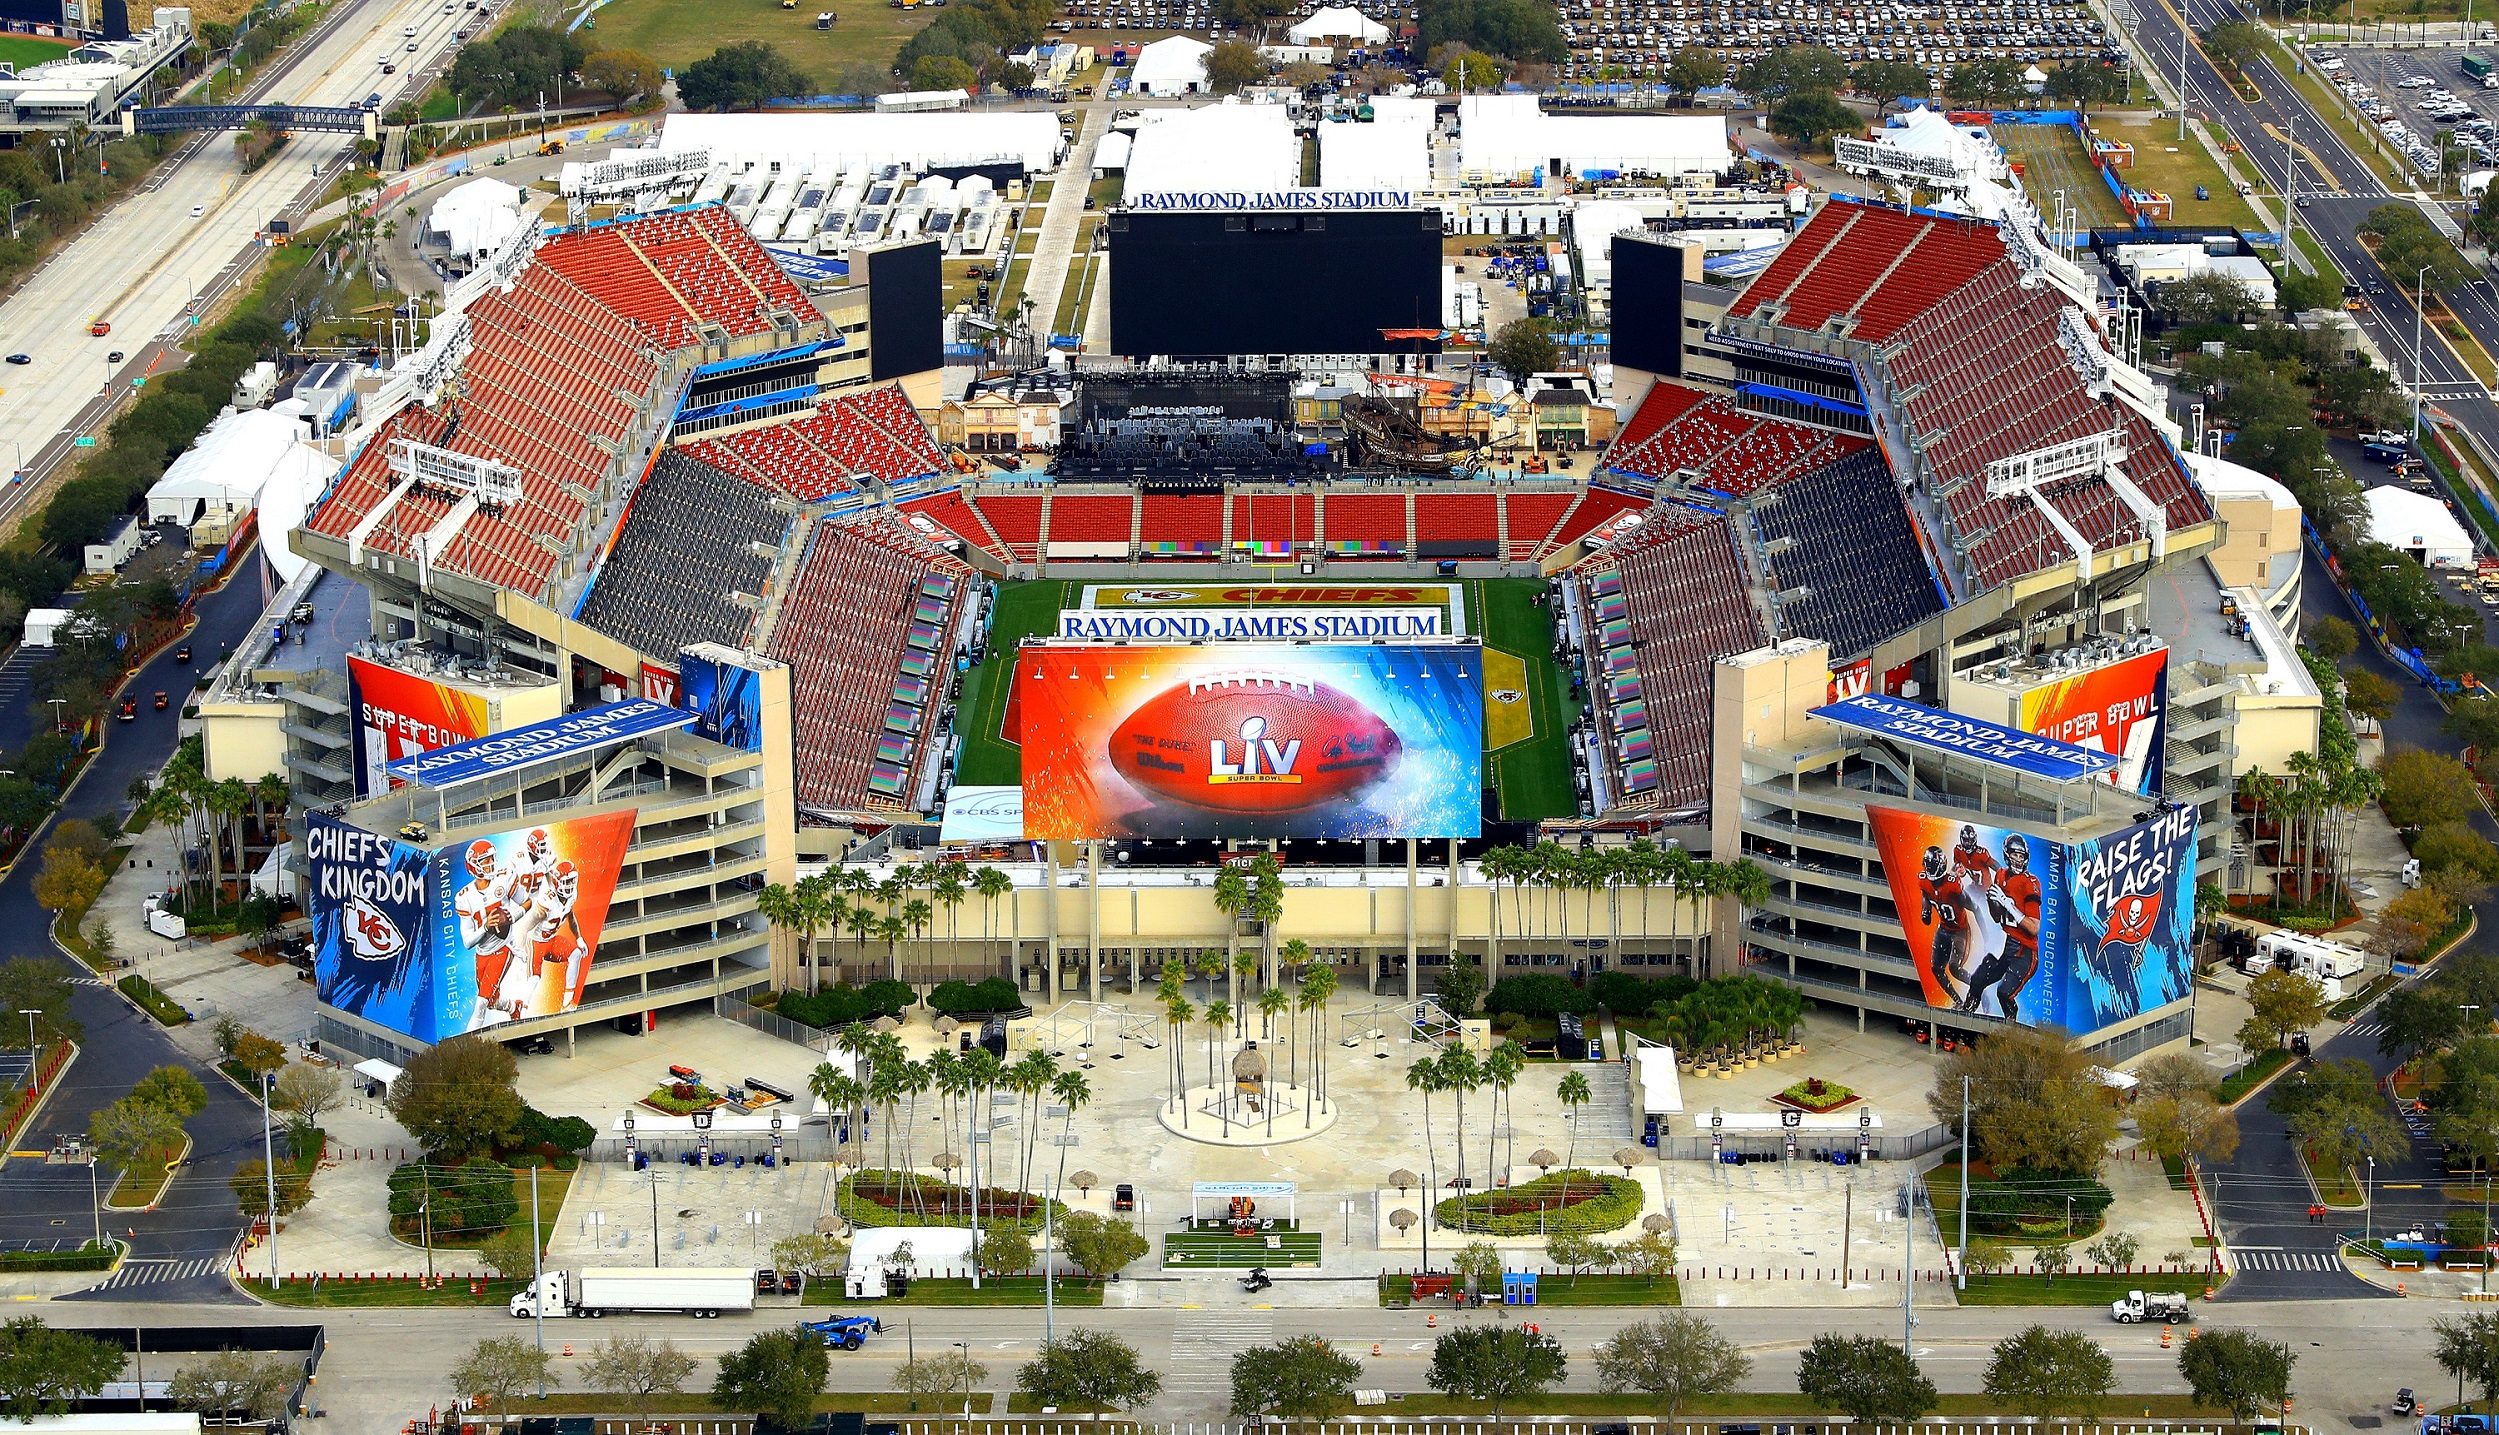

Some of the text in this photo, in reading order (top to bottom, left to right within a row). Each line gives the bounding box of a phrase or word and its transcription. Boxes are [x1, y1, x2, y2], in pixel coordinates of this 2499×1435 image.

[1141, 191, 1410, 209] RAYMOND JAMES STADIUM
[1721, 338, 1751, 349] ASSISTANCE?
[1752, 343, 1764, 352] TEXT
[1813, 356, 1825, 364] YOUR
[1376, 377, 1405, 386] SUPER
[1221, 588, 1423, 602] CHIEFS
[1064, 615, 1437, 638] RAYMOND JAMES STADIUM
[643, 669, 675, 685] SUPER BOWL
[1836, 665, 1870, 680] SUPER BOWL
[362, 702, 479, 749] SUPER BOW
[2107, 692, 2160, 727] BOWL
[395, 702, 661, 775] RAYMOND JAMES
[481, 726, 623, 766] STADIUM
[1848, 695, 2108, 768] RAYMOND JAMES
[1885, 719, 2026, 760] STADIUM
[967, 808, 1000, 816] CBS
[307, 826, 392, 868] CHIEFS
[2074, 805, 2193, 896] RAISE THE
[321, 863, 425, 907] KINGDOM
[520, 871, 545, 894] 95
[2092, 848, 2175, 916] FLAGS!
[357, 909, 392, 951] KC
[438, 858, 460, 1021] KANSAS CITY CHIEFS
[2042, 844, 2061, 1026] TAMPA BAY BUCCANEERS
[696, 1115, 709, 1127] D
[1785, 1112, 1799, 1126] C
